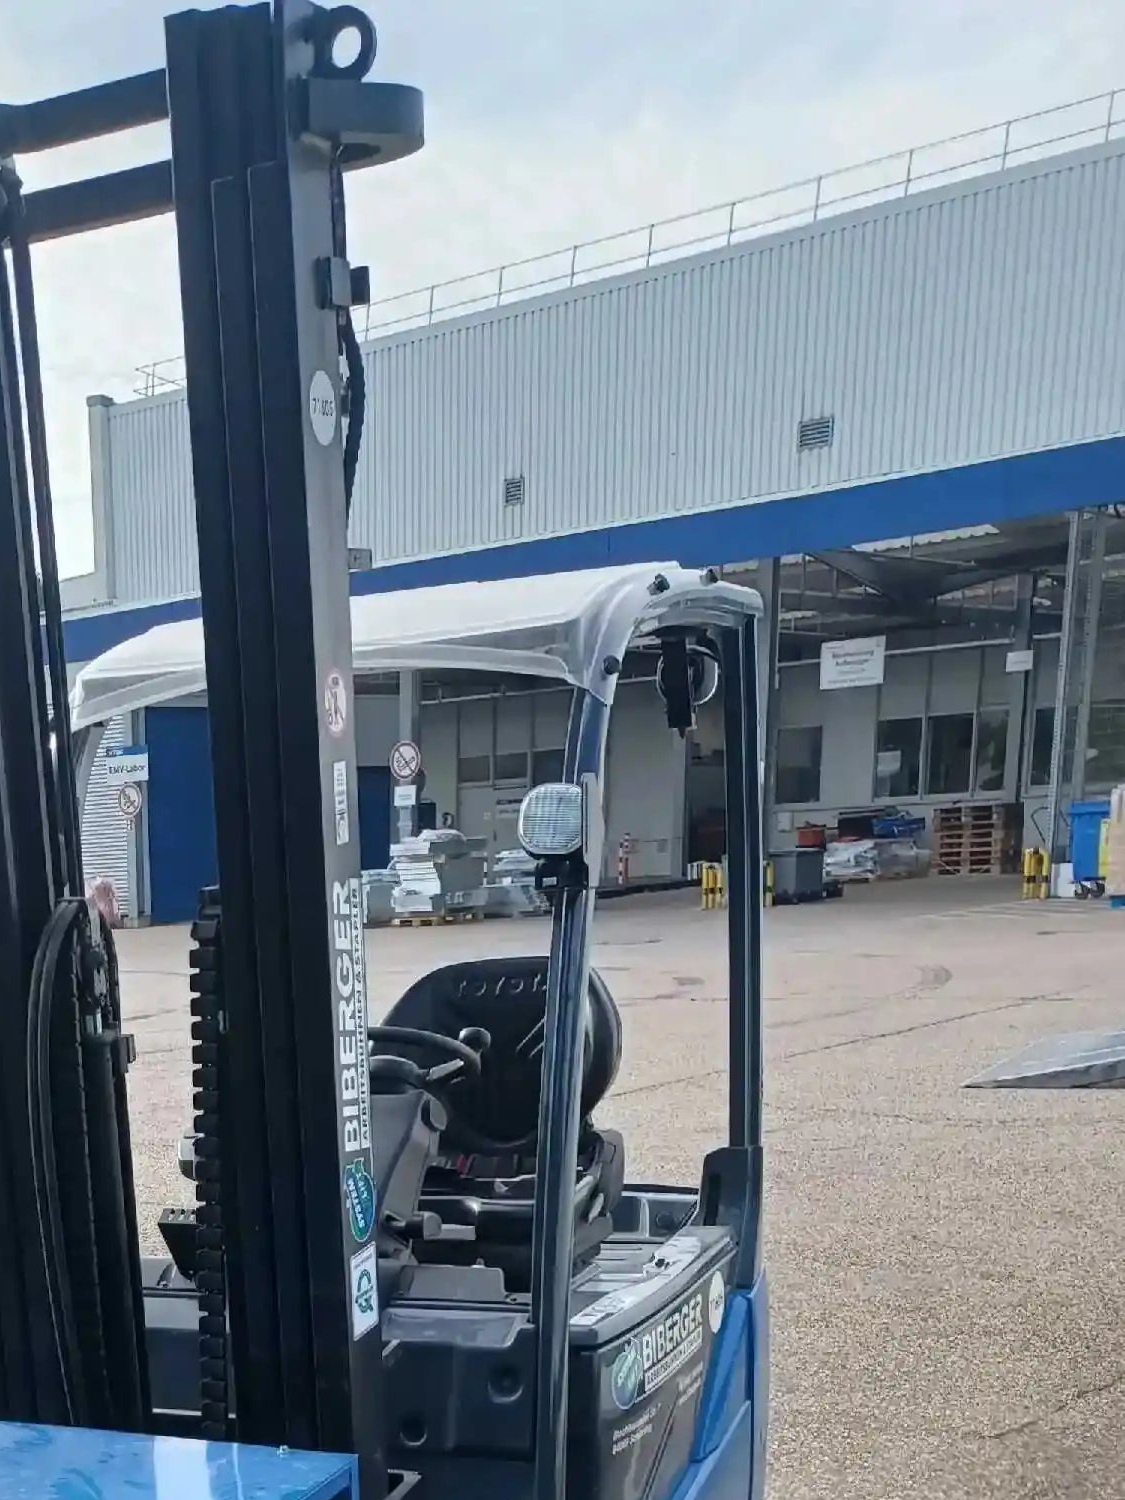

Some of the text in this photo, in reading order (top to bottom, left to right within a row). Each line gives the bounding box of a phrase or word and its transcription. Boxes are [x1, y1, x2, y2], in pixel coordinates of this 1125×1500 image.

[351, 887, 362, 967] STAPLER
[333, 880, 361, 1152] BIBERGER
[458, 973, 548, 998] TOYOT
[642, 1293, 703, 1369] BIBERGER
